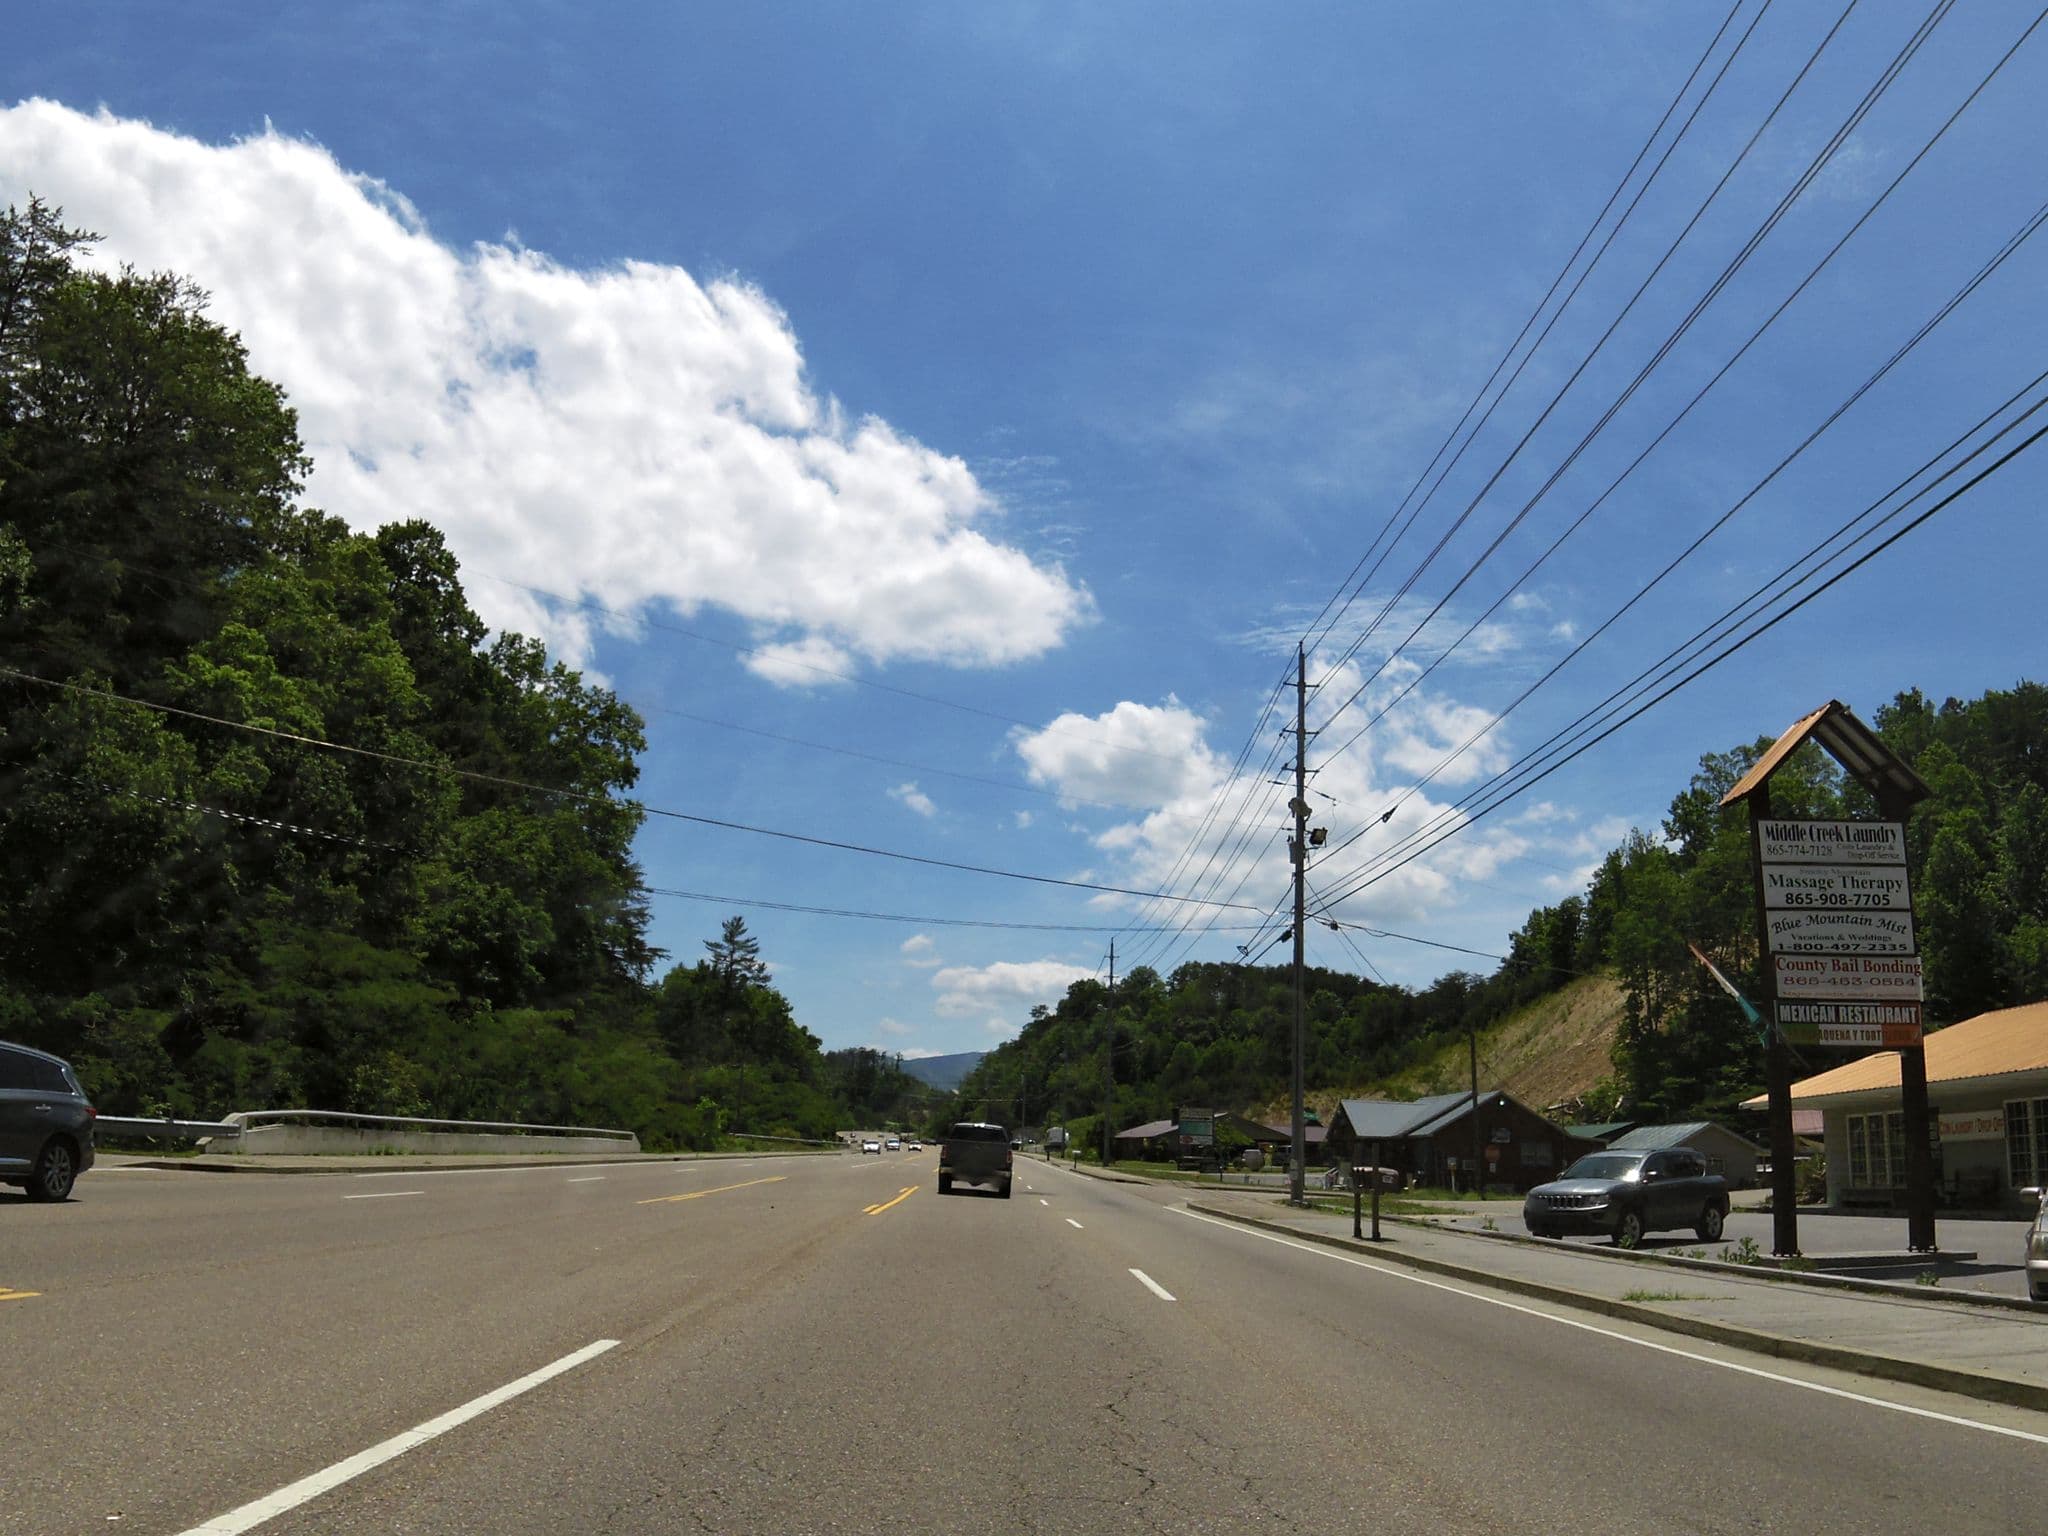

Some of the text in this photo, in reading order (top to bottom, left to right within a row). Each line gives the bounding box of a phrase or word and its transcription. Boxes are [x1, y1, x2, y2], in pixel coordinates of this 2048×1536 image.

[1765, 823, 1897, 844] Middle Creek Laundry
[1766, 844, 1833, 857] 865-774-7128
[1768, 873, 1904, 893] Massage Therapy
[1785, 893, 1891, 906] 865-908-7705
[1771, 914, 1908, 935] Blue Mountain Mist
[1777, 943, 1908, 952] 1-800-497-2335
[1790, 933, 1892, 943] Vacations & Weddings
[1775, 956, 1922, 976] County Bail Bonding
[1779, 1005, 1917, 1024] MEXICAN RESTAURANT
